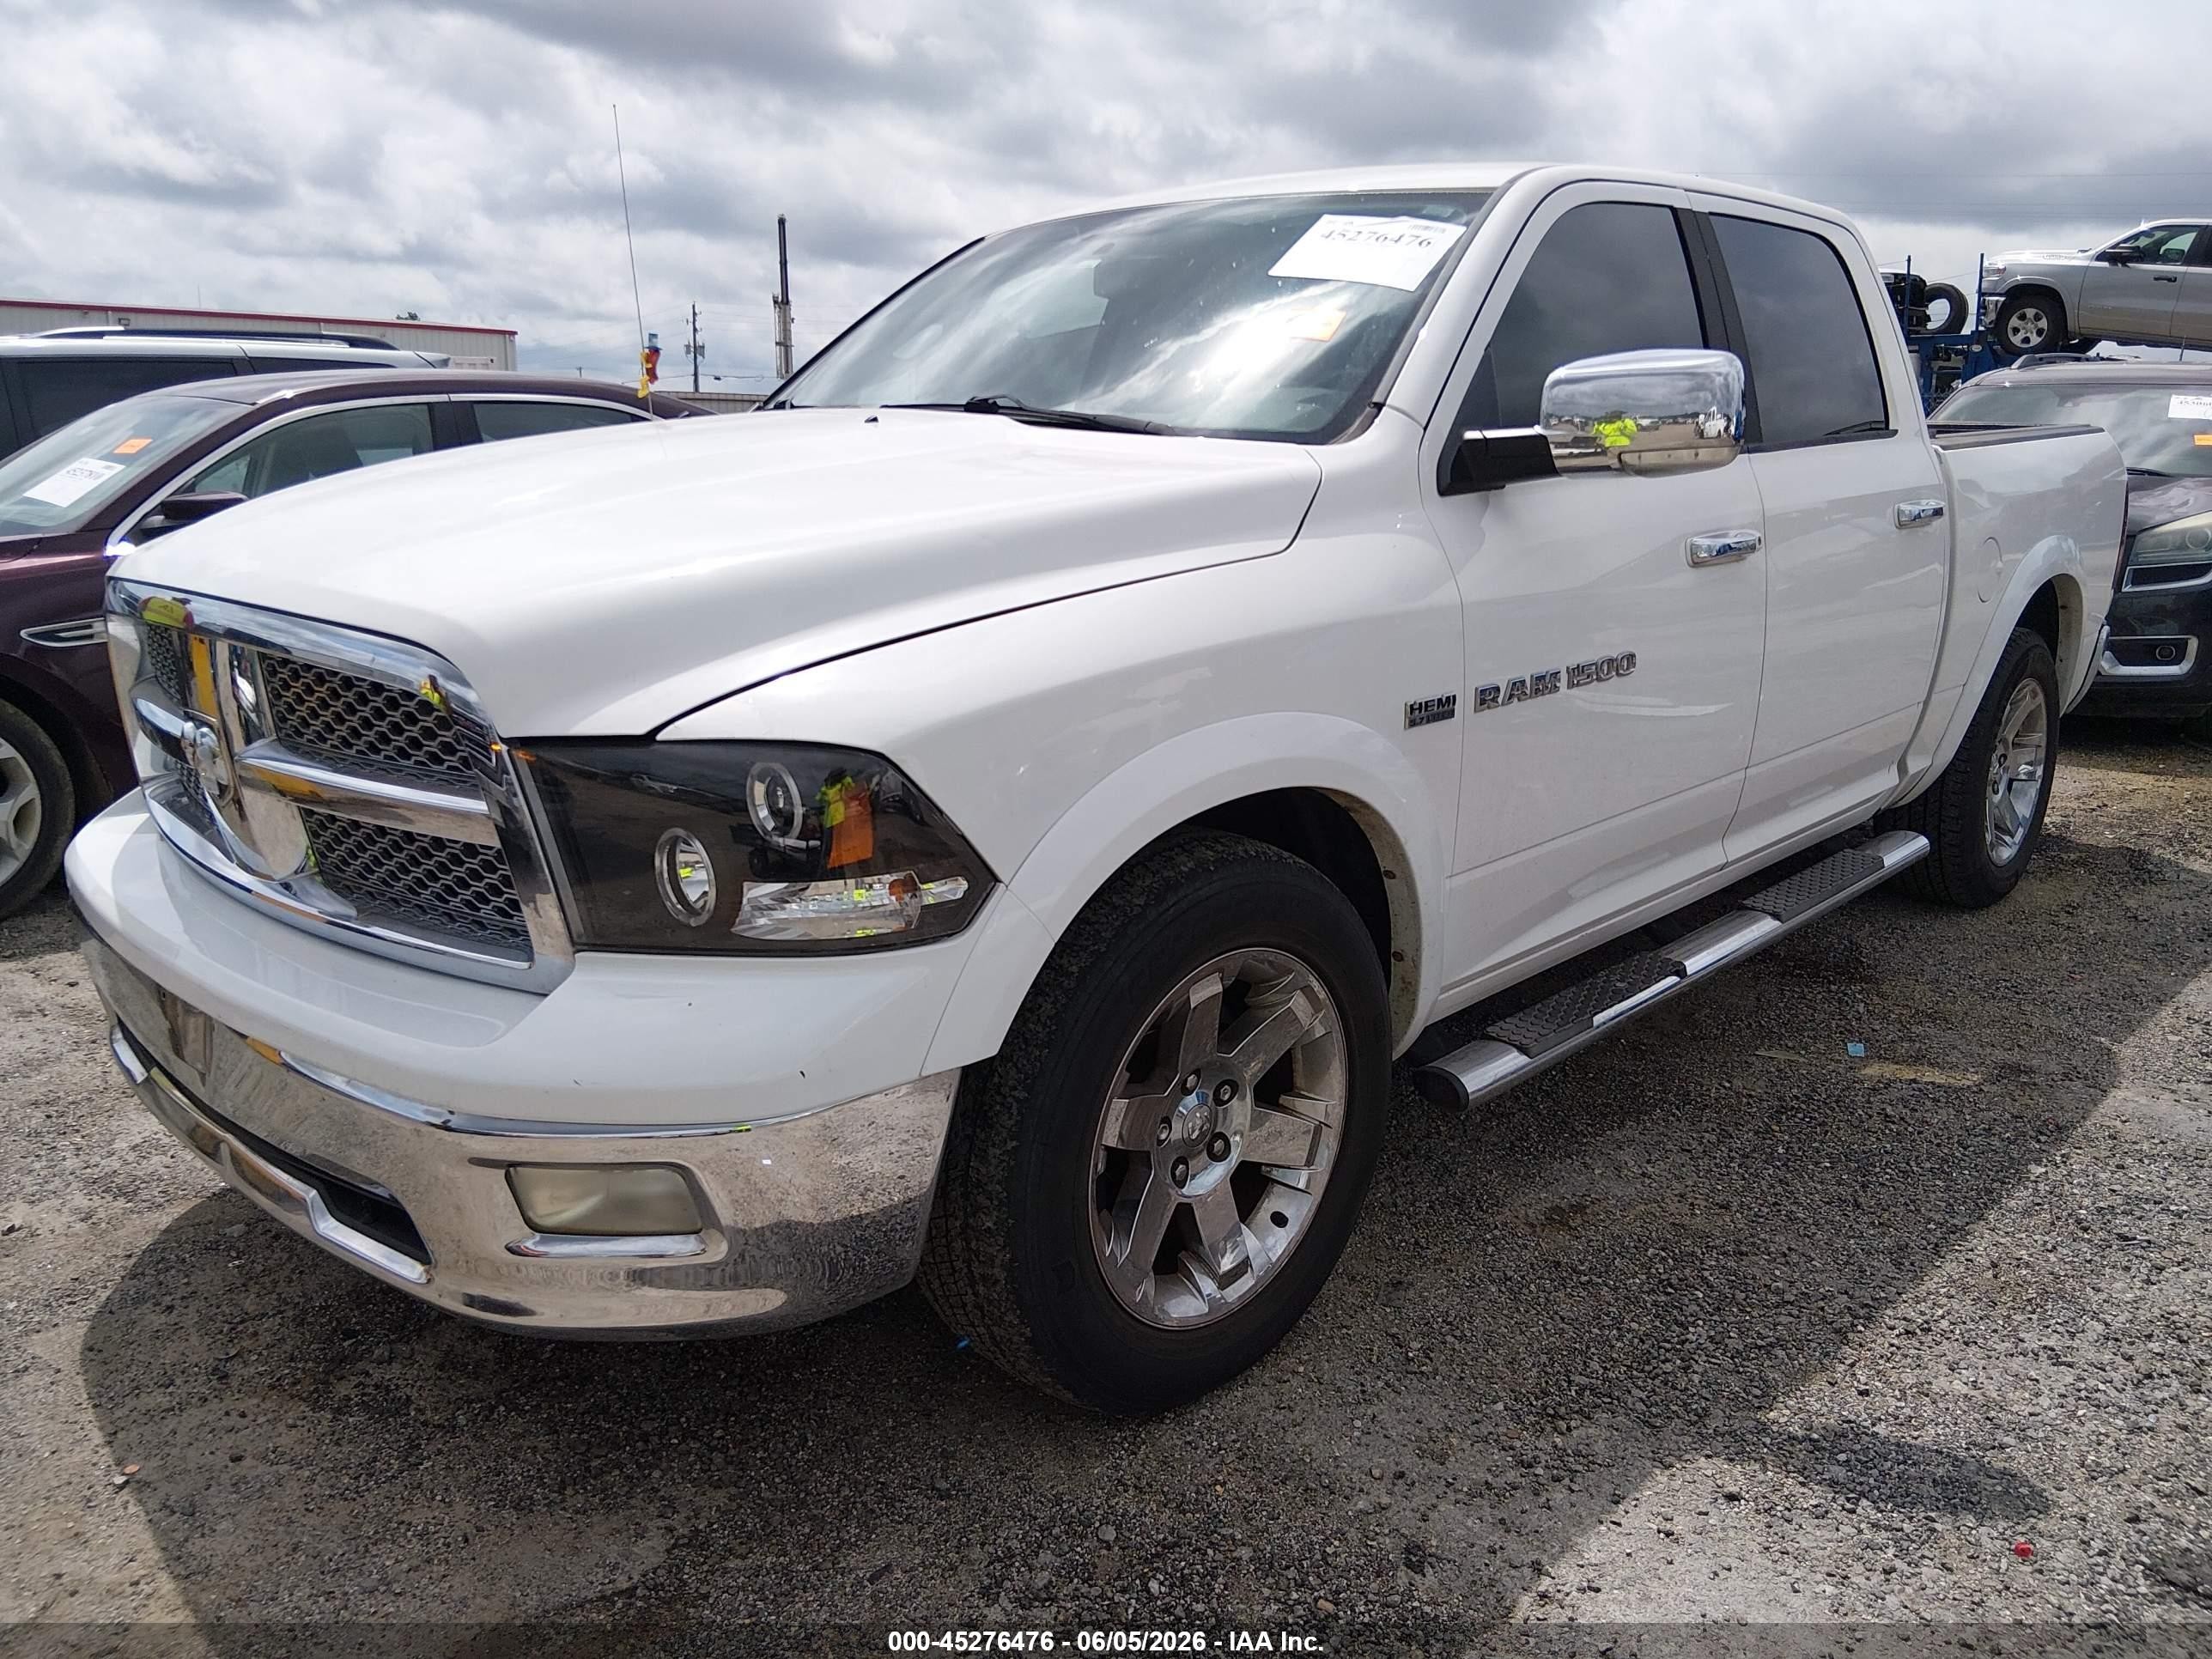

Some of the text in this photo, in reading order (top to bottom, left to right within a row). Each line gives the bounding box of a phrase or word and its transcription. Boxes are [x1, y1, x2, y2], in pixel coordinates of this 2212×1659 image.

[1320, 228, 1433, 248] 45276476
[1474, 651, 1637, 714] RAM 1500
[1409, 694, 1457, 715] HEMI
